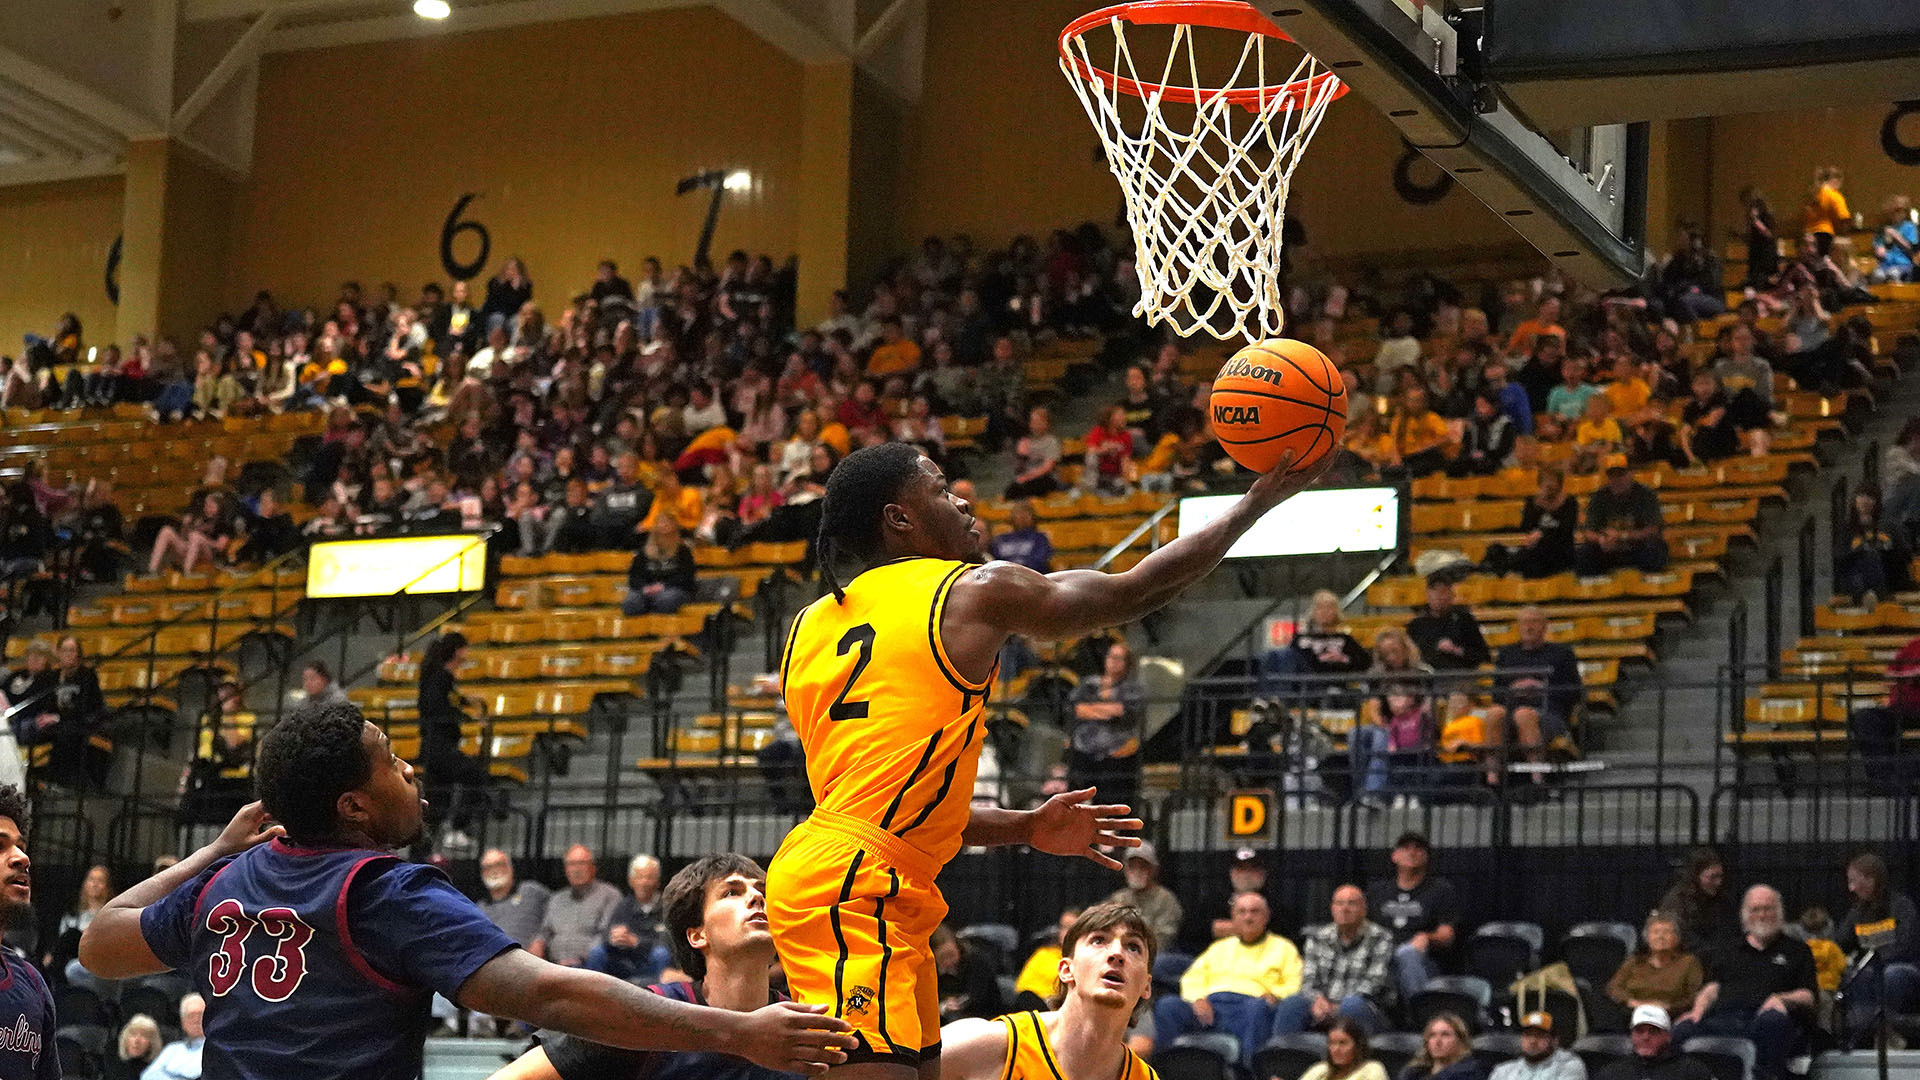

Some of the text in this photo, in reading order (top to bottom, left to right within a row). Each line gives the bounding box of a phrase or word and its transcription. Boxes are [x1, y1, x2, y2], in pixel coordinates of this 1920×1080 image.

[441, 193, 490, 281] 6
[1213, 405, 1260, 425] NCAA
[829, 622, 877, 721] 2
[1232, 795, 1266, 835] D
[206, 898, 316, 1003] 33
